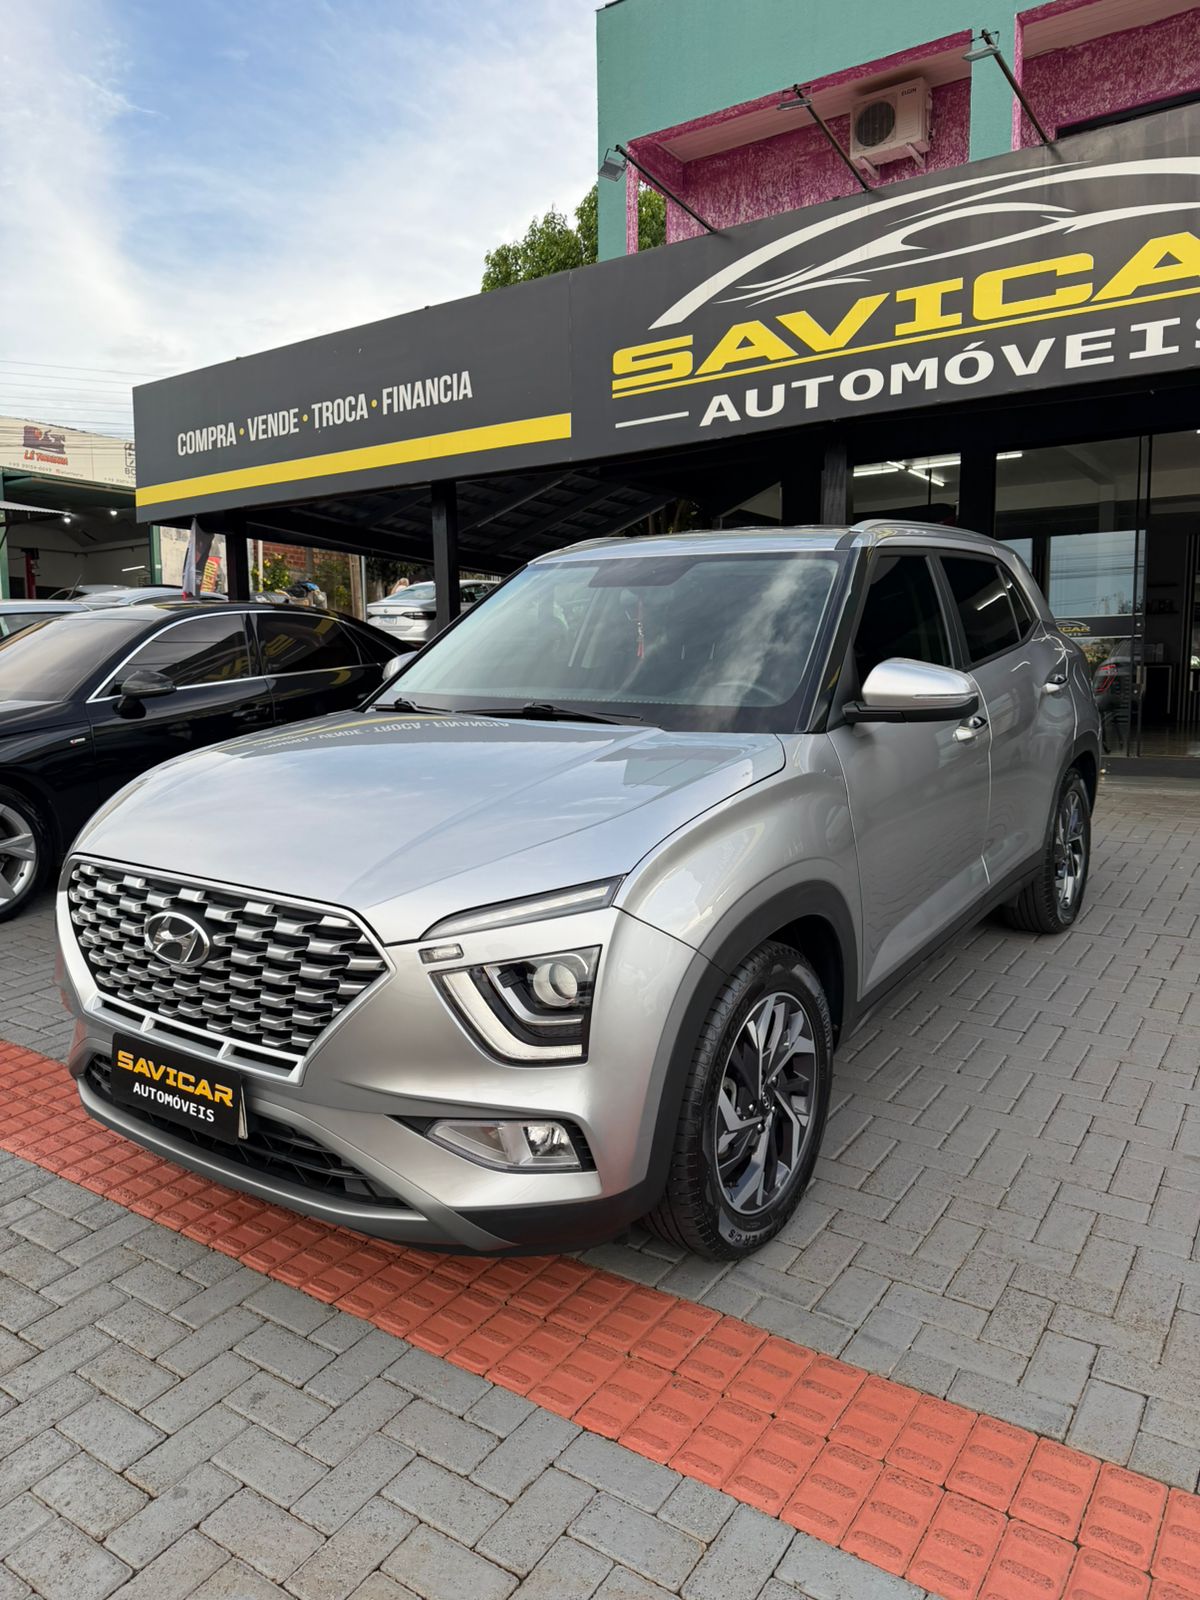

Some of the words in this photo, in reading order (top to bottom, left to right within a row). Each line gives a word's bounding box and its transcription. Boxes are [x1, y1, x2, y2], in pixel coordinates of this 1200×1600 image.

[611, 231, 1200, 392] SAVICA
[177, 421, 237, 456] COMPRA
[247, 407, 300, 442] VENDE
[311, 393, 369, 429] TROCA
[382, 370, 473, 415] FINANCIA
[699, 316, 1200, 428] AUTOMÓVEI
[117, 1050, 233, 1107] SAVICAR
[133, 1081, 215, 1122] AUTOMÓVEIS
